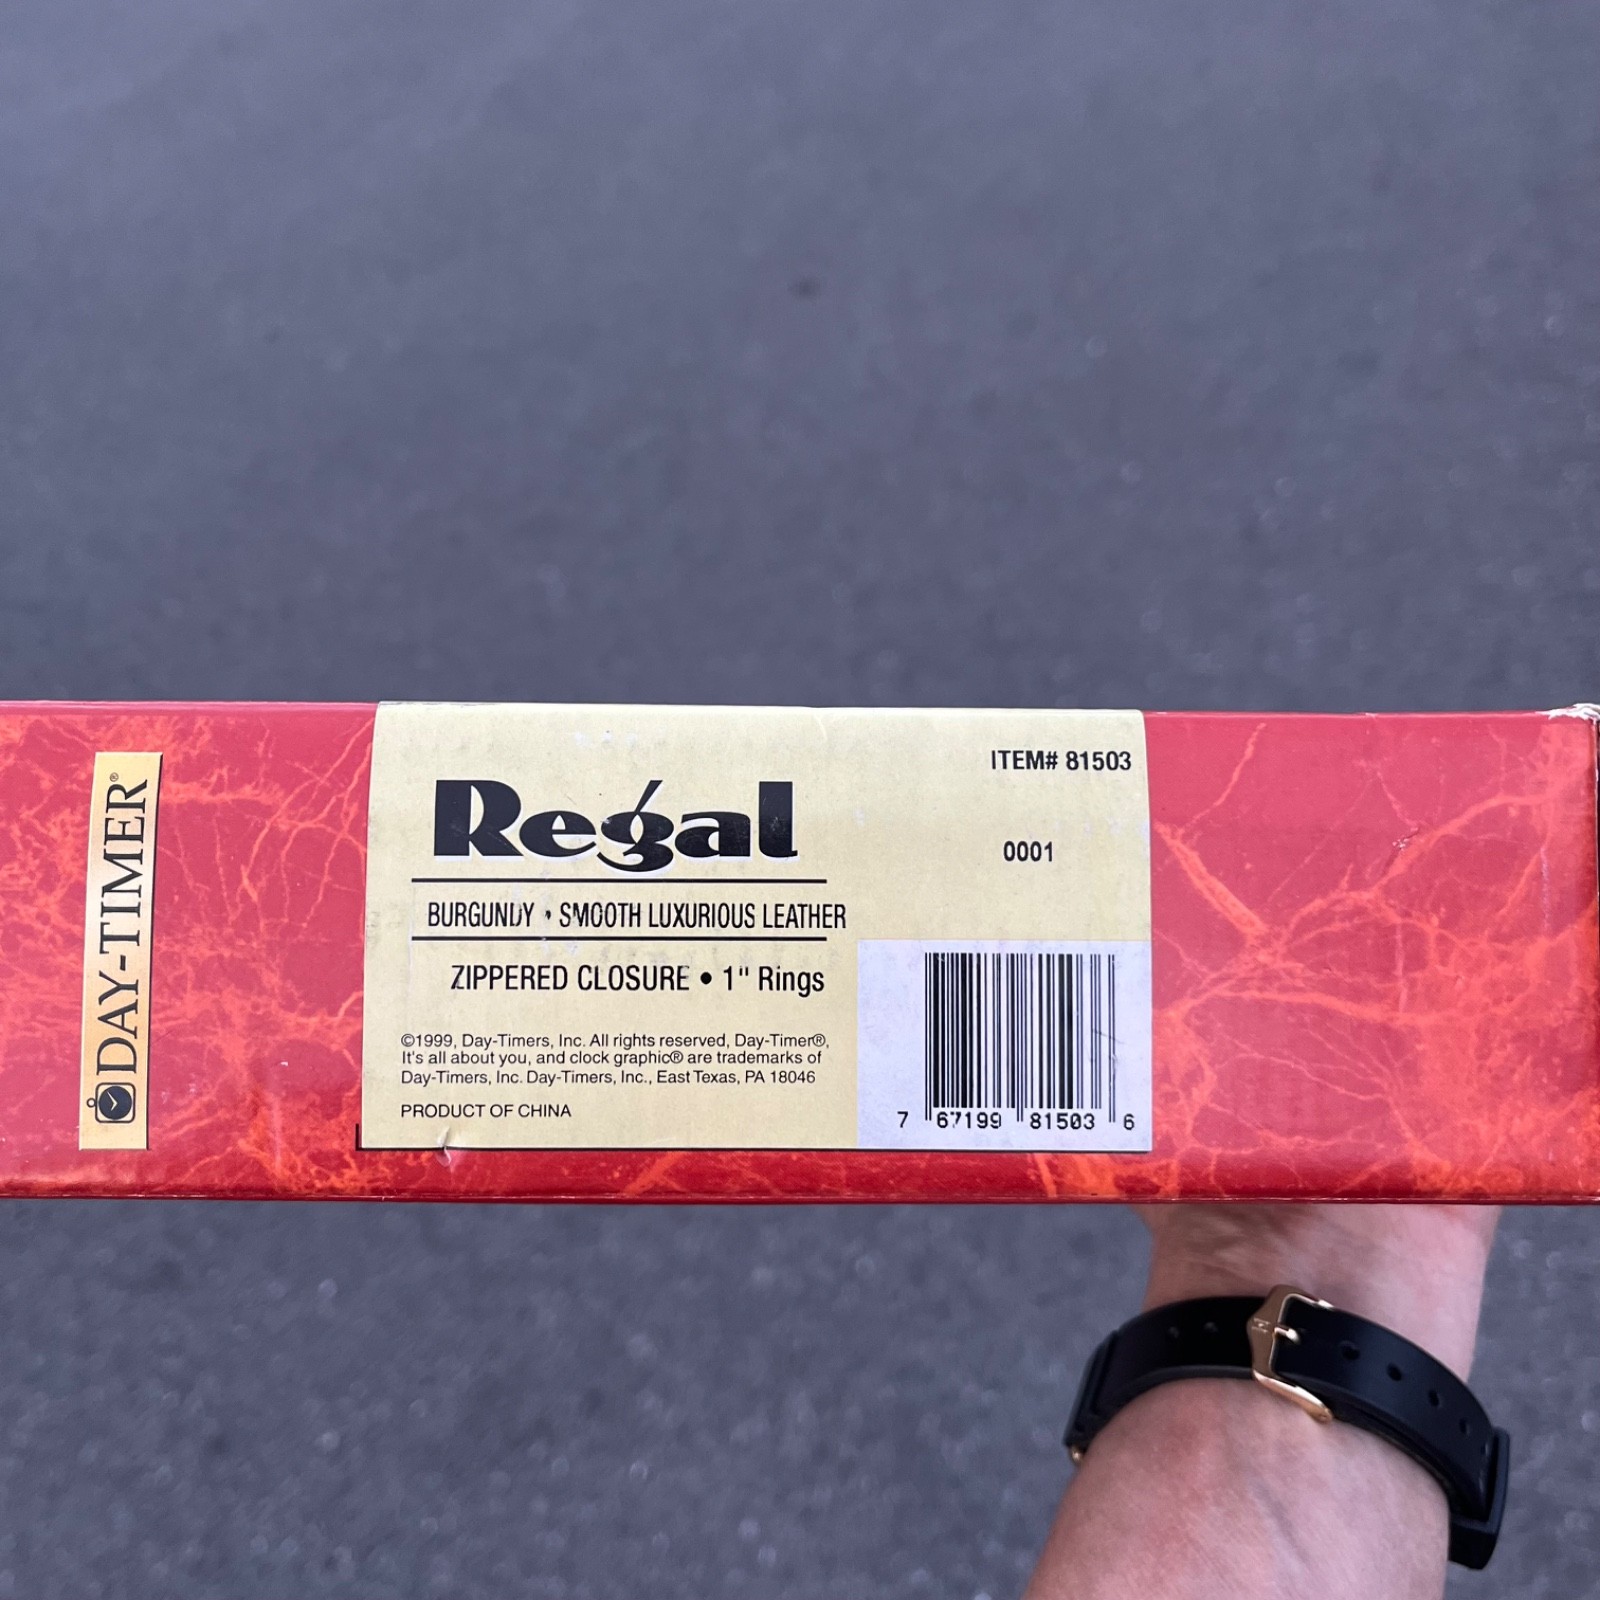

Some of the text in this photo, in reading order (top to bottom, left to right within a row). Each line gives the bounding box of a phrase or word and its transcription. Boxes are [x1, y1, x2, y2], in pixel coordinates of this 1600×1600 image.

[992, 750, 1131, 771] ITEM# 81503
[1004, 841, 1052, 862] 0001
[560, 902, 640, 928] SMOOTH
[649, 903, 755, 928] LUXURIOUS
[763, 904, 846, 928] LEATHER
[451, 965, 824, 997] ZIPPERED CLOSURE 1" Rings
[401, 1034, 456, 1048] ©1999,
[463, 1034, 553, 1050] Day-Timers,
[560, 1034, 585, 1047] Inc.
[590, 1034, 608, 1046] All
[614, 1033, 655, 1050] rights
[660, 1033, 729, 1048] reserved,
[402, 1051, 423, 1064] It's
[430, 1051, 446, 1064] all
[451, 1051, 494, 1064] about
[499, 1054, 531, 1067] you,
[537, 1051, 565, 1064] and
[570, 1051, 609, 1064] clock
[688, 1054, 712, 1063] are
[717, 1051, 802, 1064] trademarks
[808, 1051, 821, 1064] of
[402, 1070, 815, 1086] Day-Timers, Inc. Day-Timers, Inc., East Texas, PA 18046
[401, 1104, 571, 1118] PRODUCT OF CHINA
[897, 1111, 1136, 1131] 7 67199 81503 6
